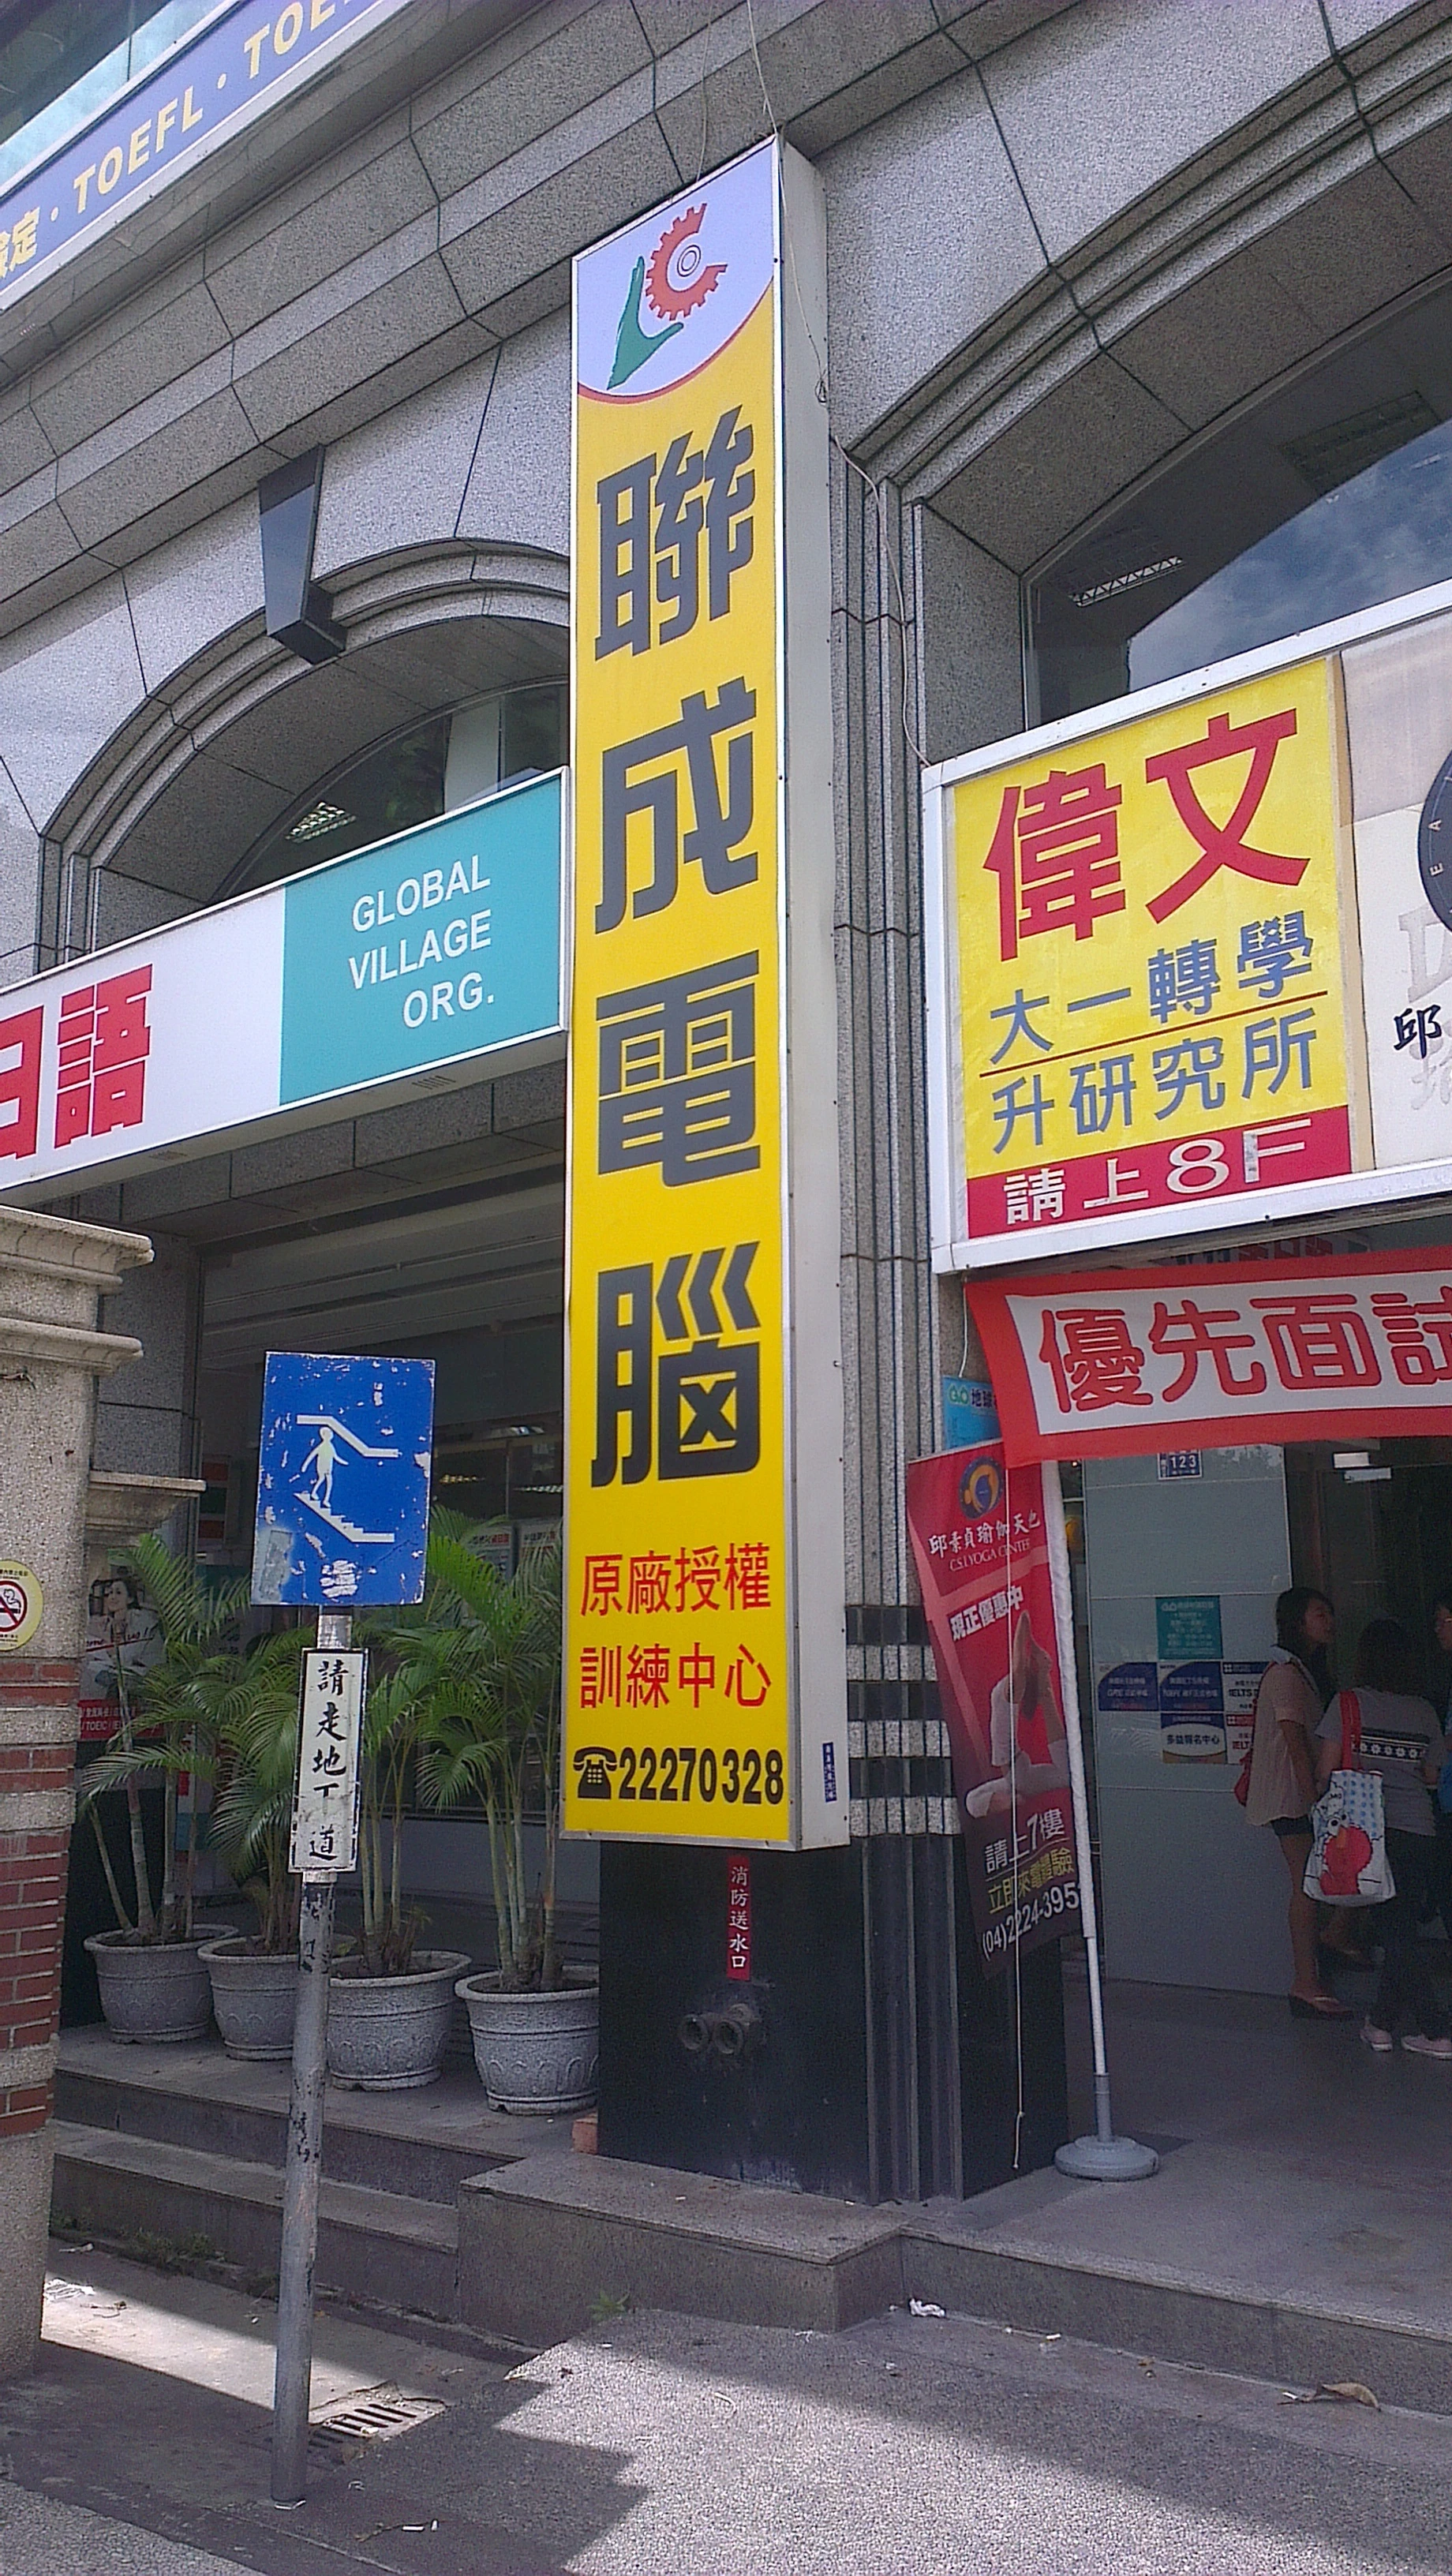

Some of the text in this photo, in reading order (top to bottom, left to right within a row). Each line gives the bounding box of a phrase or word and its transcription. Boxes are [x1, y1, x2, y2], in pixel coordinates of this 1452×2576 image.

[73, 85, 204, 214] TOEFL
[244, 0, 354, 79] TOE
[982, 707, 1311, 963] 偉文
[352, 855, 491, 933] GLOBAL
[349, 908, 492, 990] VILLAGE
[591, 404, 761, 1488] 聯成電腦
[403, 972, 495, 1028] ORG.
[990, 909, 1314, 1065] 大一轉學
[1394, 1004, 1443, 1059] 邱
[992, 1007, 1318, 1155] 升研究所
[1170, 1455, 1196, 1469] 123
[580, 1541, 772, 1616] 原廠授權
[949, 1585, 1024, 1642] 現正優惠中
[580, 1642, 772, 1709] 訓練中心
[618, 1746, 784, 1805] 22270328
[729, 1866, 749, 1968] 消防送水口
[982, 1881, 1082, 1961] (04)2224-395
